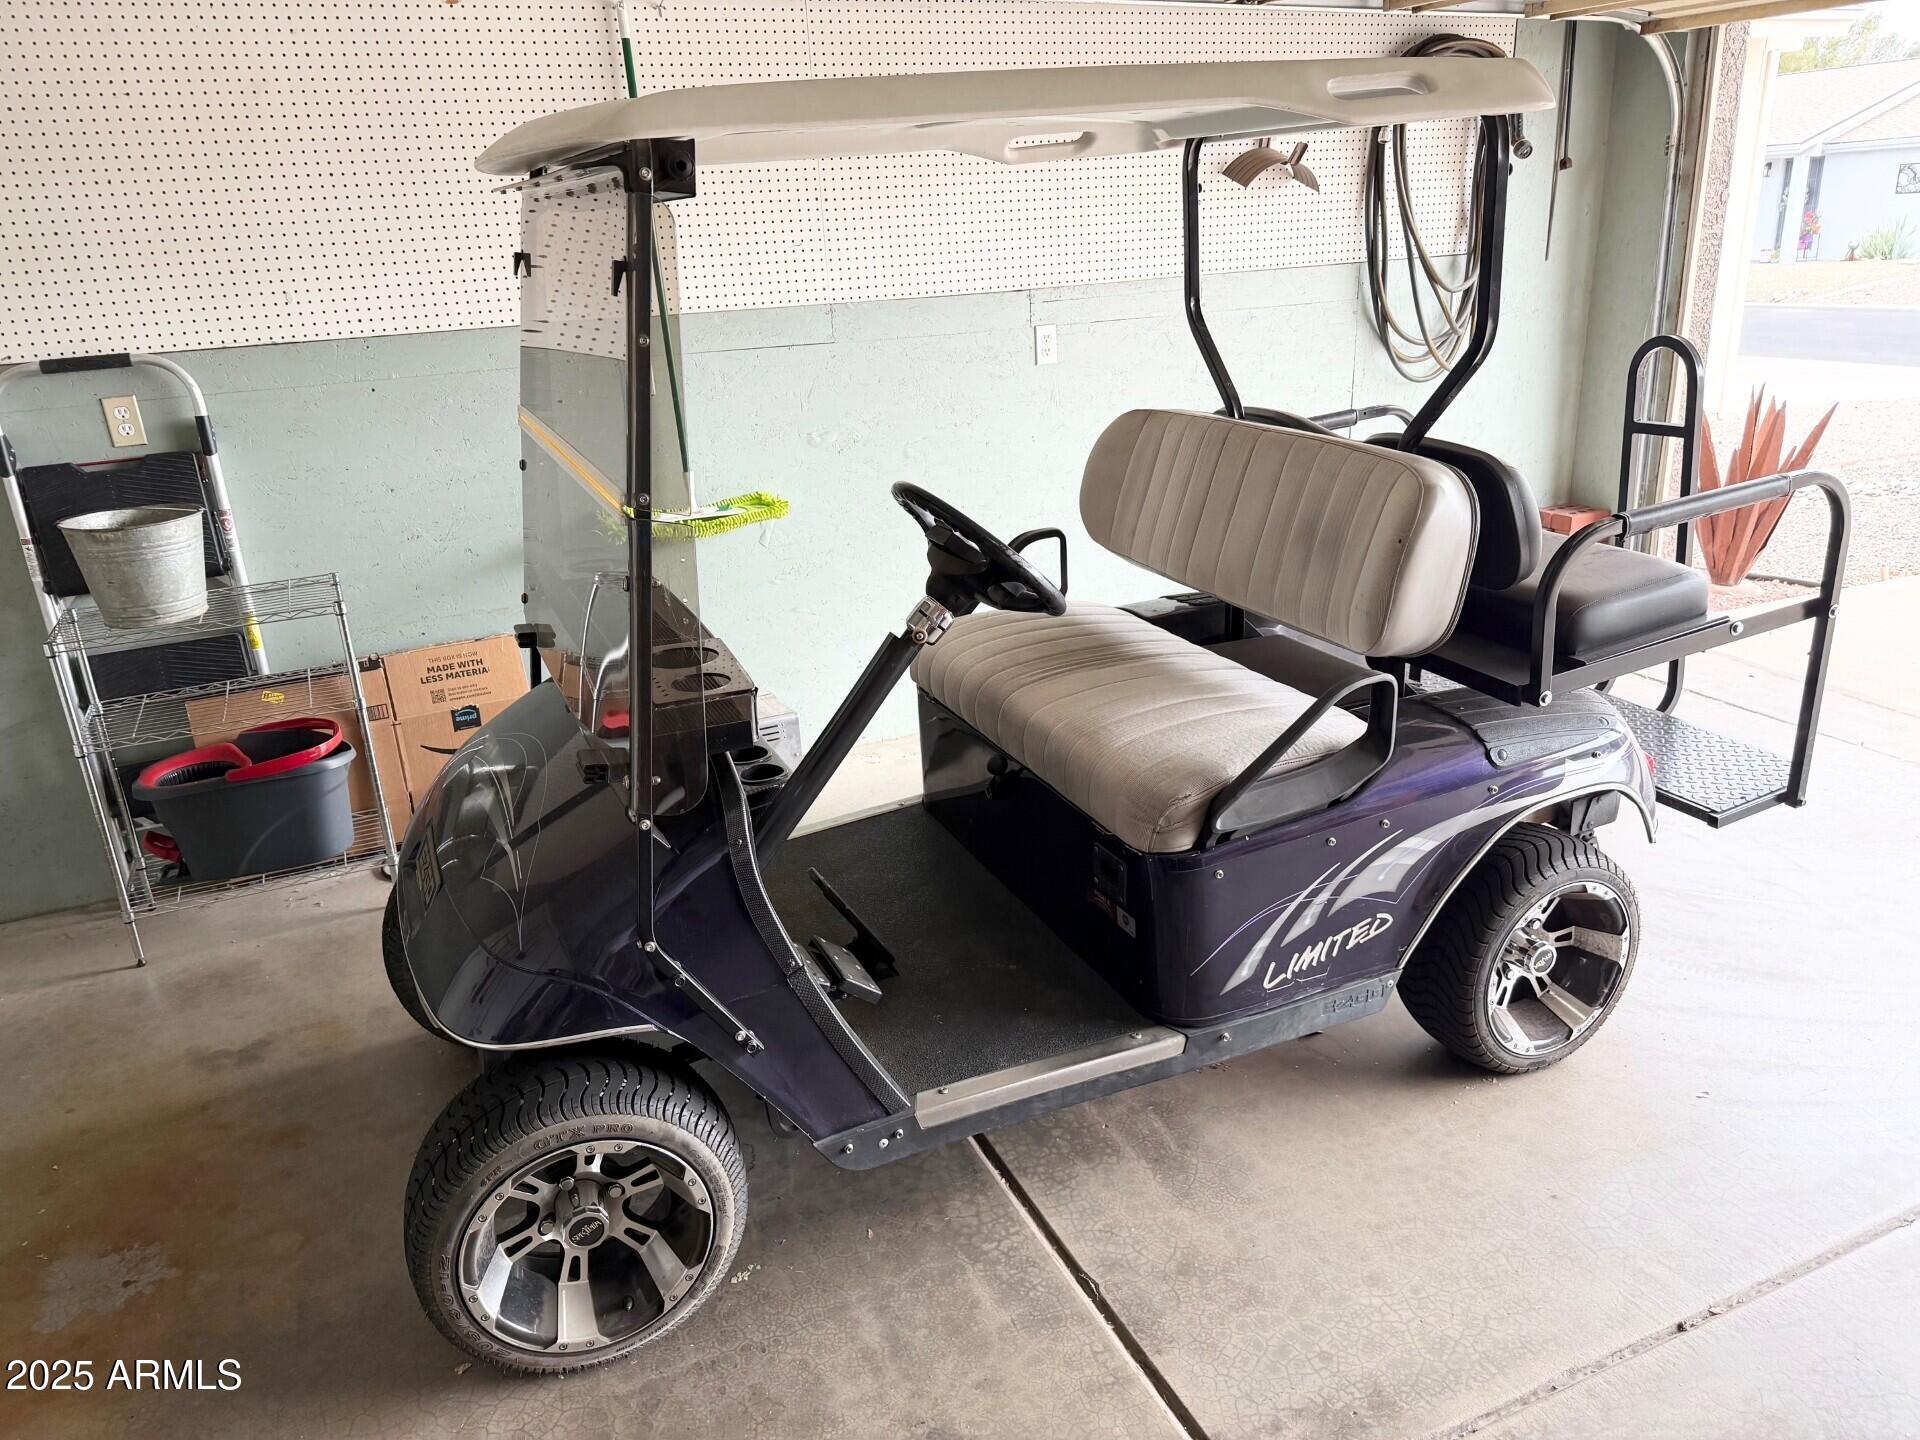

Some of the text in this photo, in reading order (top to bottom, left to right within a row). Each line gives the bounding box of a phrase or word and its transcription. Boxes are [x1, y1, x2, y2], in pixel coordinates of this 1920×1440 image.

[426, 658, 484, 674] MADE WITH
[420, 674, 444, 685] LESS
[455, 712, 477, 722] prime
[1263, 912, 1394, 989] LIMITED
[533, 1123, 633, 1151] GTX PRO
